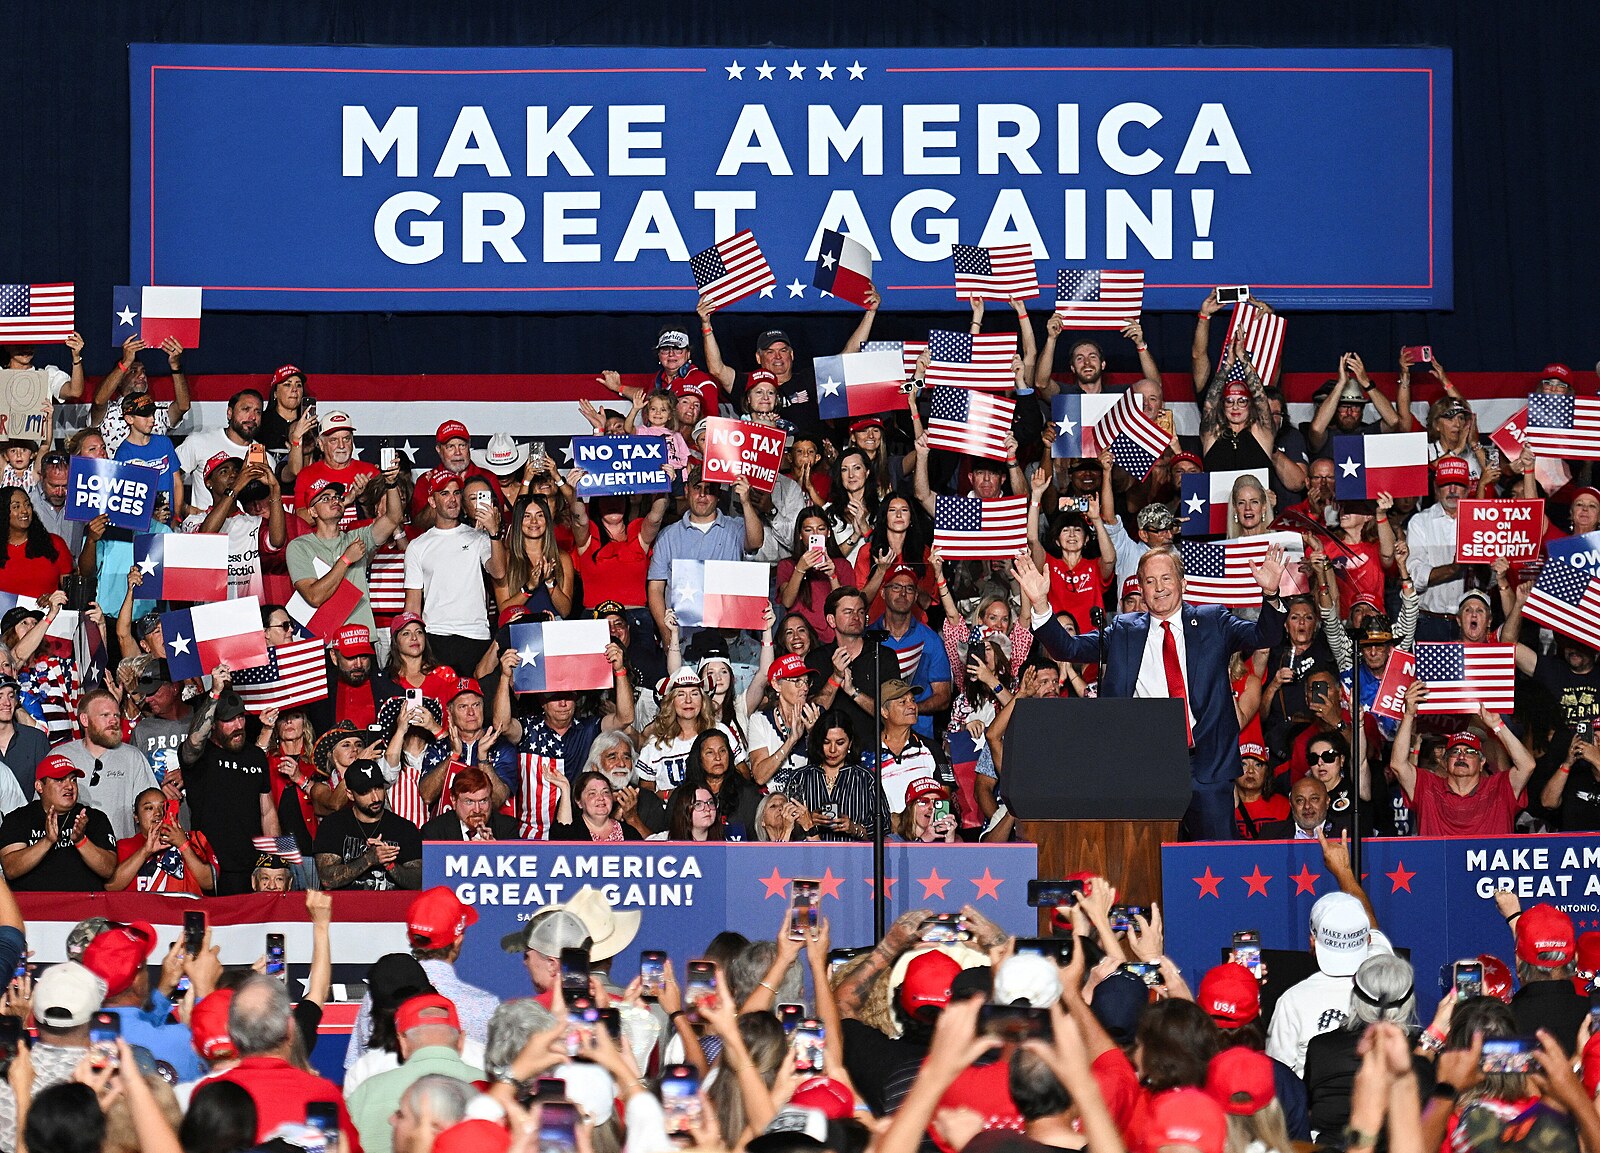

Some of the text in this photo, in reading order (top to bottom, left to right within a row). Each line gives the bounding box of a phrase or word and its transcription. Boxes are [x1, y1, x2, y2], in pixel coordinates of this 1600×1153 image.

[342, 102, 1252, 177] MAKE AMERICA
[374, 188, 1215, 265] GREAT AGAIN!
[712, 429, 782, 457] NO TAX
[579, 444, 662, 461] NO TAX
[742, 451, 758, 462] ON
[612, 460, 632, 471] ON
[707, 458, 776, 483] OVERTIME
[77, 473, 149, 499] LOWER
[580, 470, 667, 487] OVERTIME
[75, 490, 144, 516] PRICES
[1473, 507, 1531, 521] NO TAX
[1496, 521, 1511, 530] ON
[1472, 531, 1530, 544] SOCIAL
[1462, 543, 1536, 558] SECURITY
[1125, 578, 1139, 587] TRU
[340, 631, 353, 639] MAKE
[344, 637, 358, 646] GREAT
[147, 734, 188, 751] PRO
[445, 855, 702, 878] MAKE AMERICA
[1466, 848, 1549, 872] MAKE
[455, 883, 694, 906] GREAT GAIN!
[1476, 875, 1573, 900] GREAT
[1322, 927, 1369, 941] MAKE AMERICA
[1324, 938, 1365, 949] GREAT AGAIN
[1213, 1000, 1236, 1014] USA
